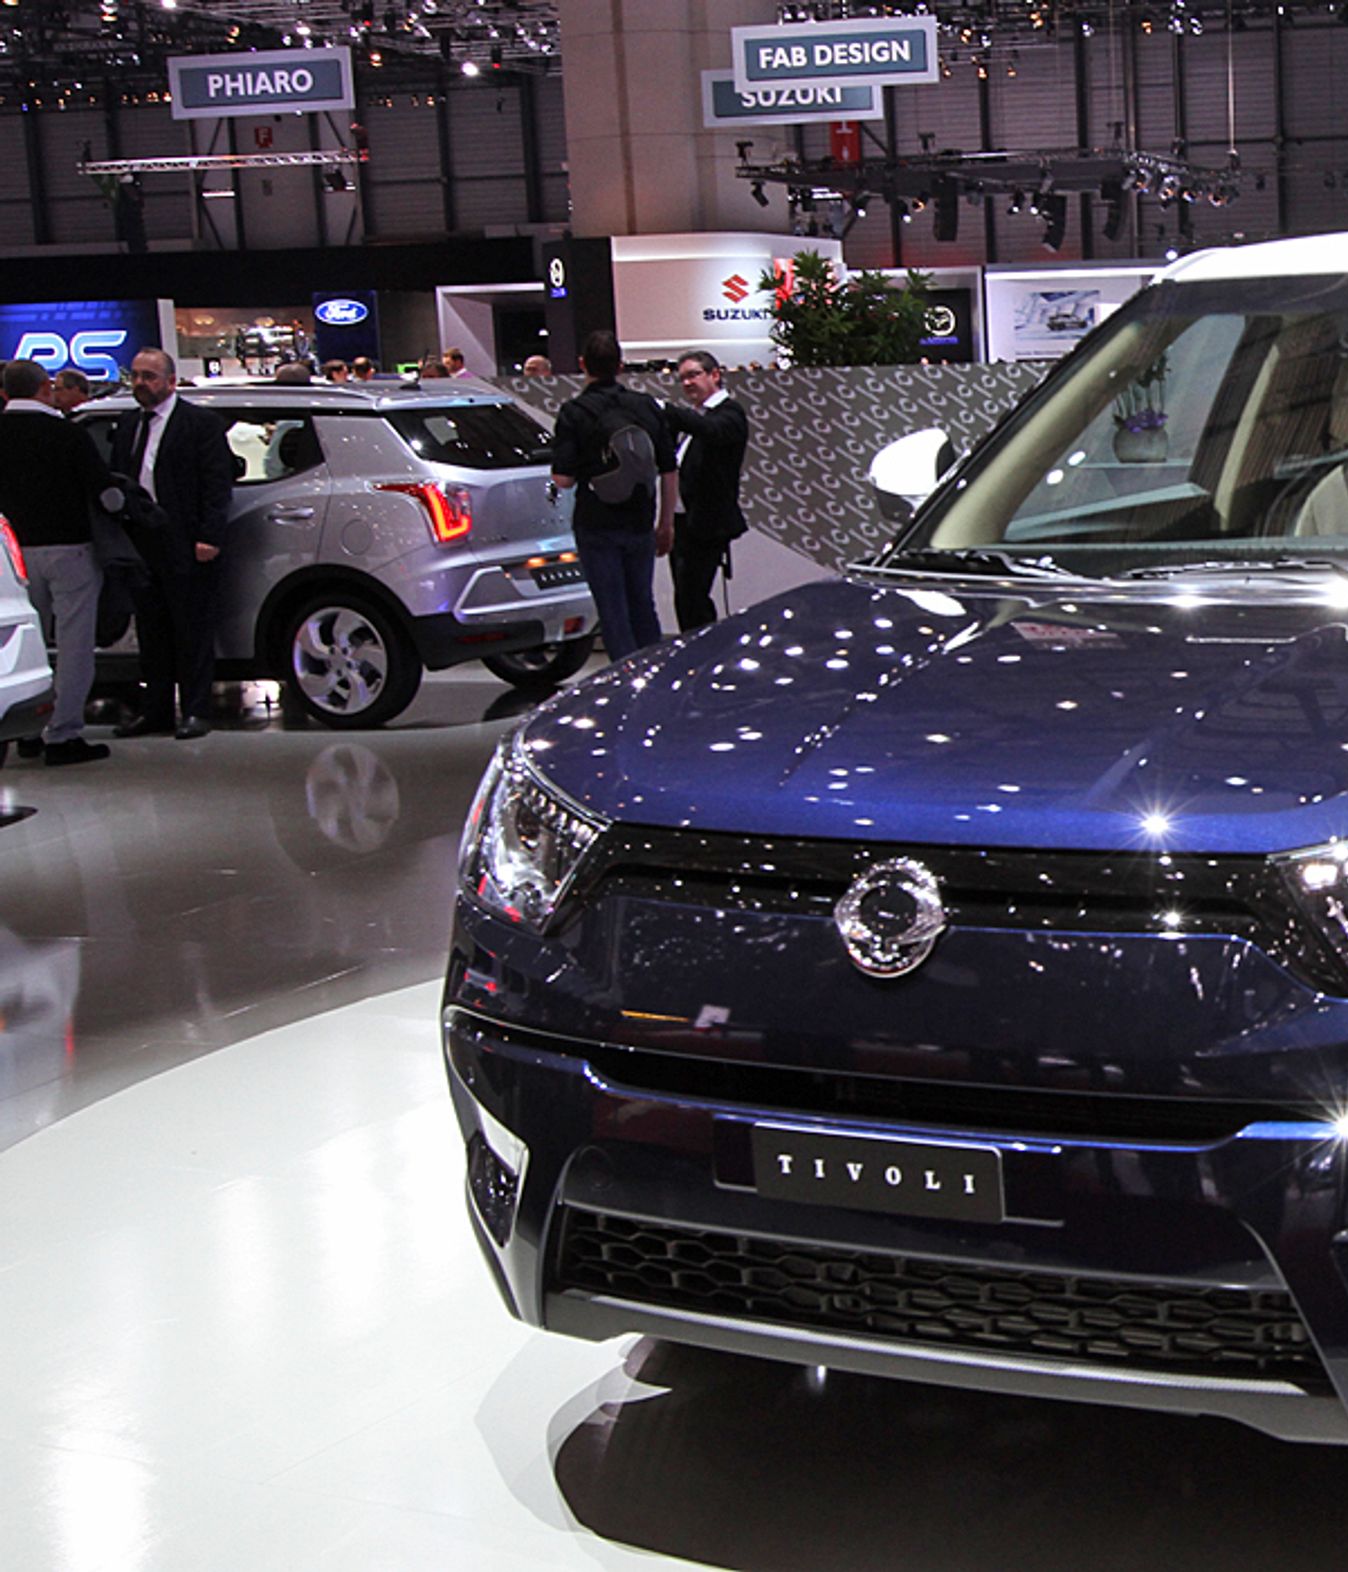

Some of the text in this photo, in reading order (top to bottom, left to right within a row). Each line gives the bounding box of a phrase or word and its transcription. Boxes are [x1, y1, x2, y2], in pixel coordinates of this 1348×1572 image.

[758, 40, 911, 69] FAB DESIGN
[207, 69, 313, 98] PHIARO
[777, 1154, 975, 1194] TIVOLI
